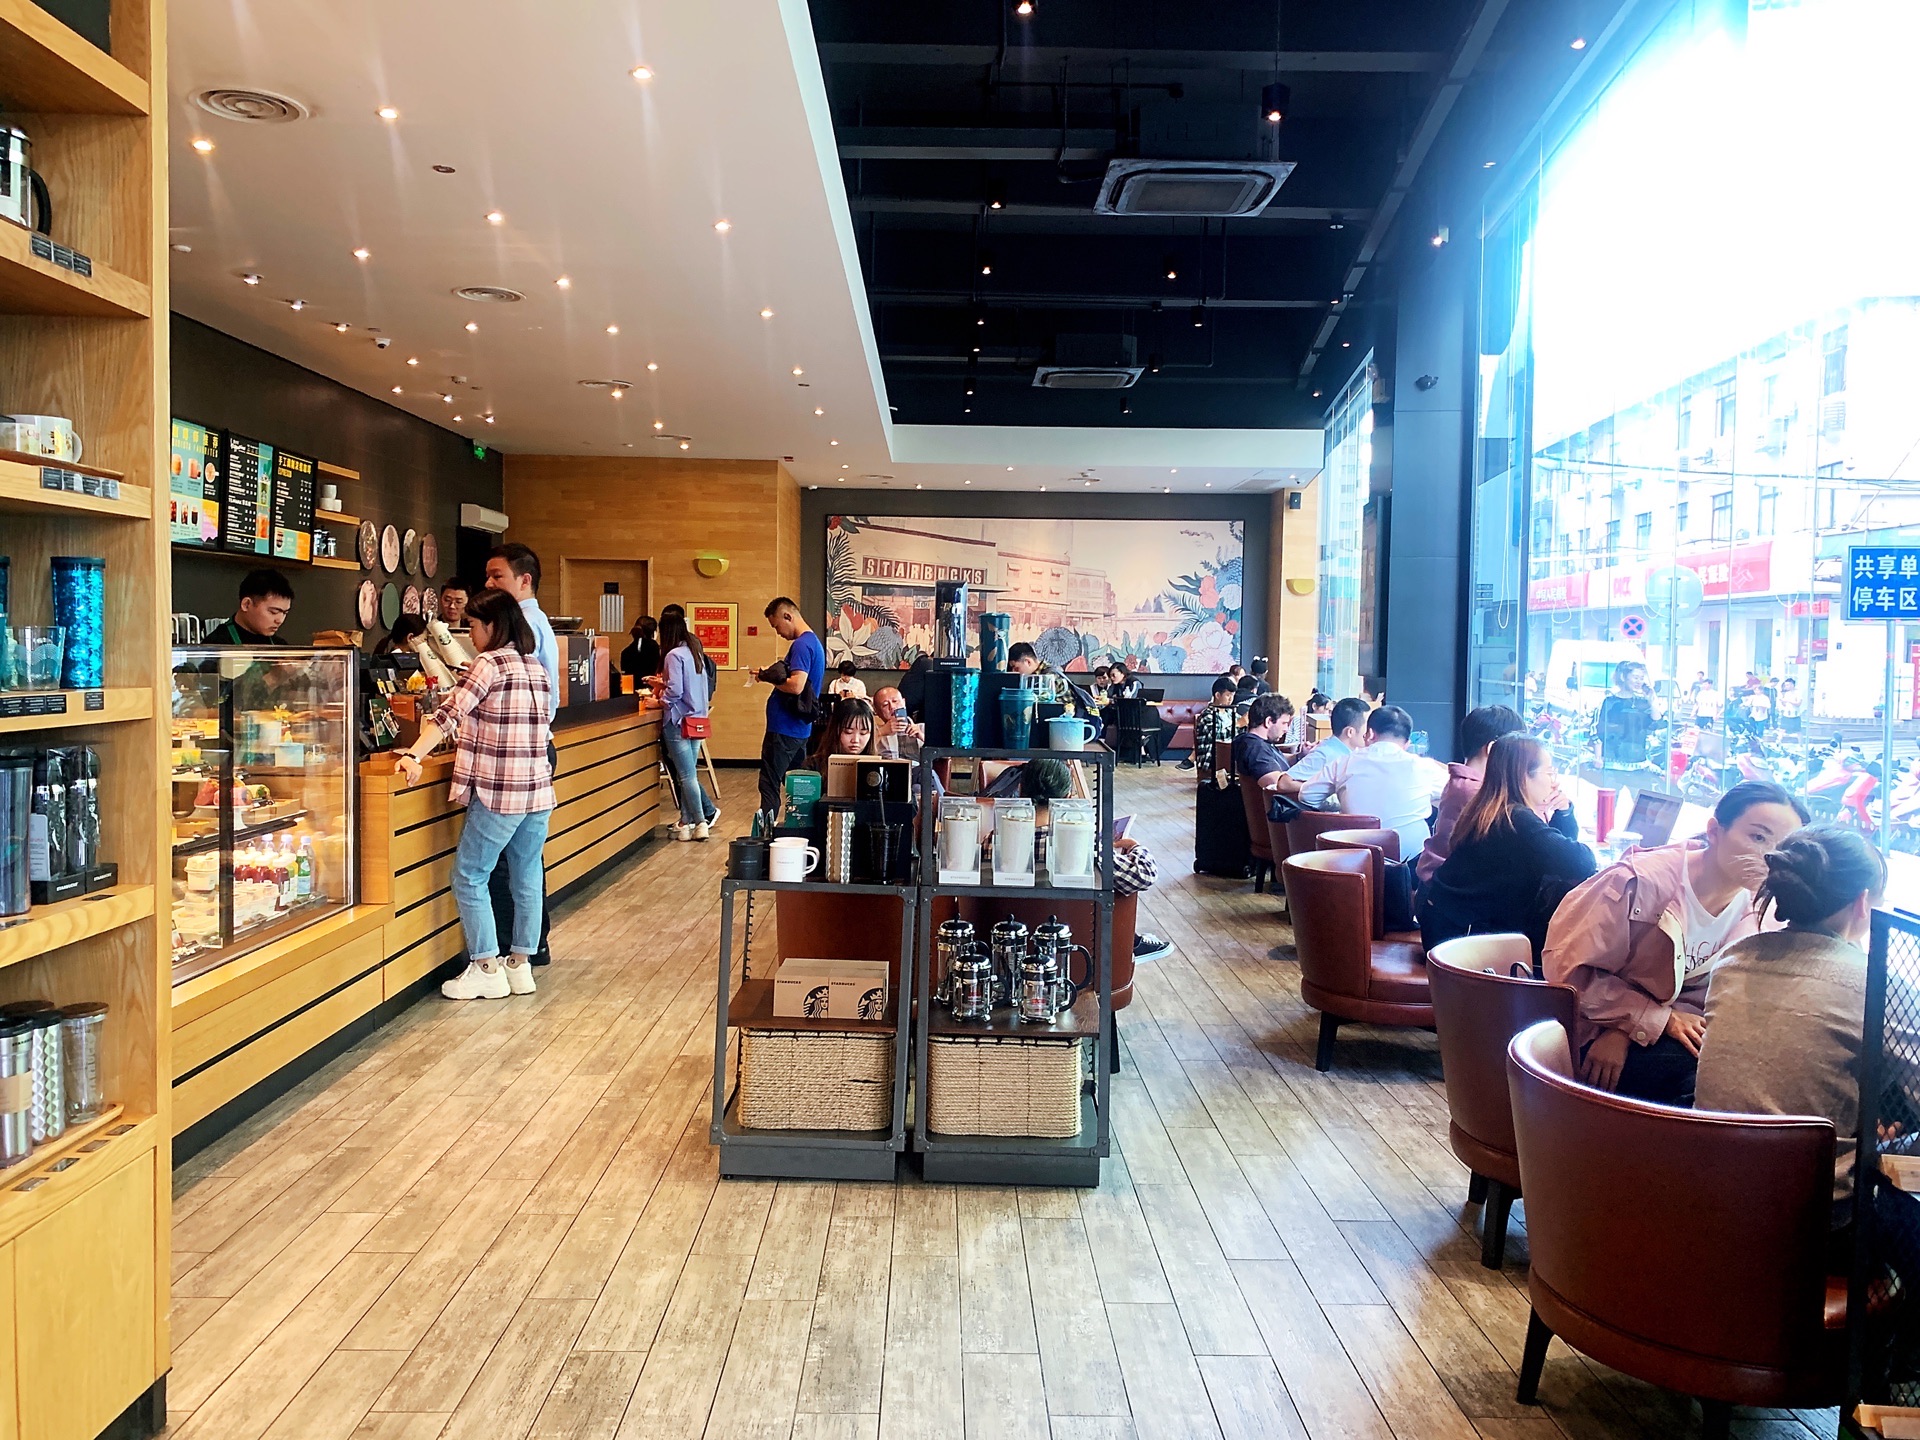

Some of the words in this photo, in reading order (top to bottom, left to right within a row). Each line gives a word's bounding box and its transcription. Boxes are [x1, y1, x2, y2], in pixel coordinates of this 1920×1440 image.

[866, 558, 983, 585] STARBUCKS
[1854, 554, 1919, 580] 共享单
[1852, 586, 1918, 612] 停车区
